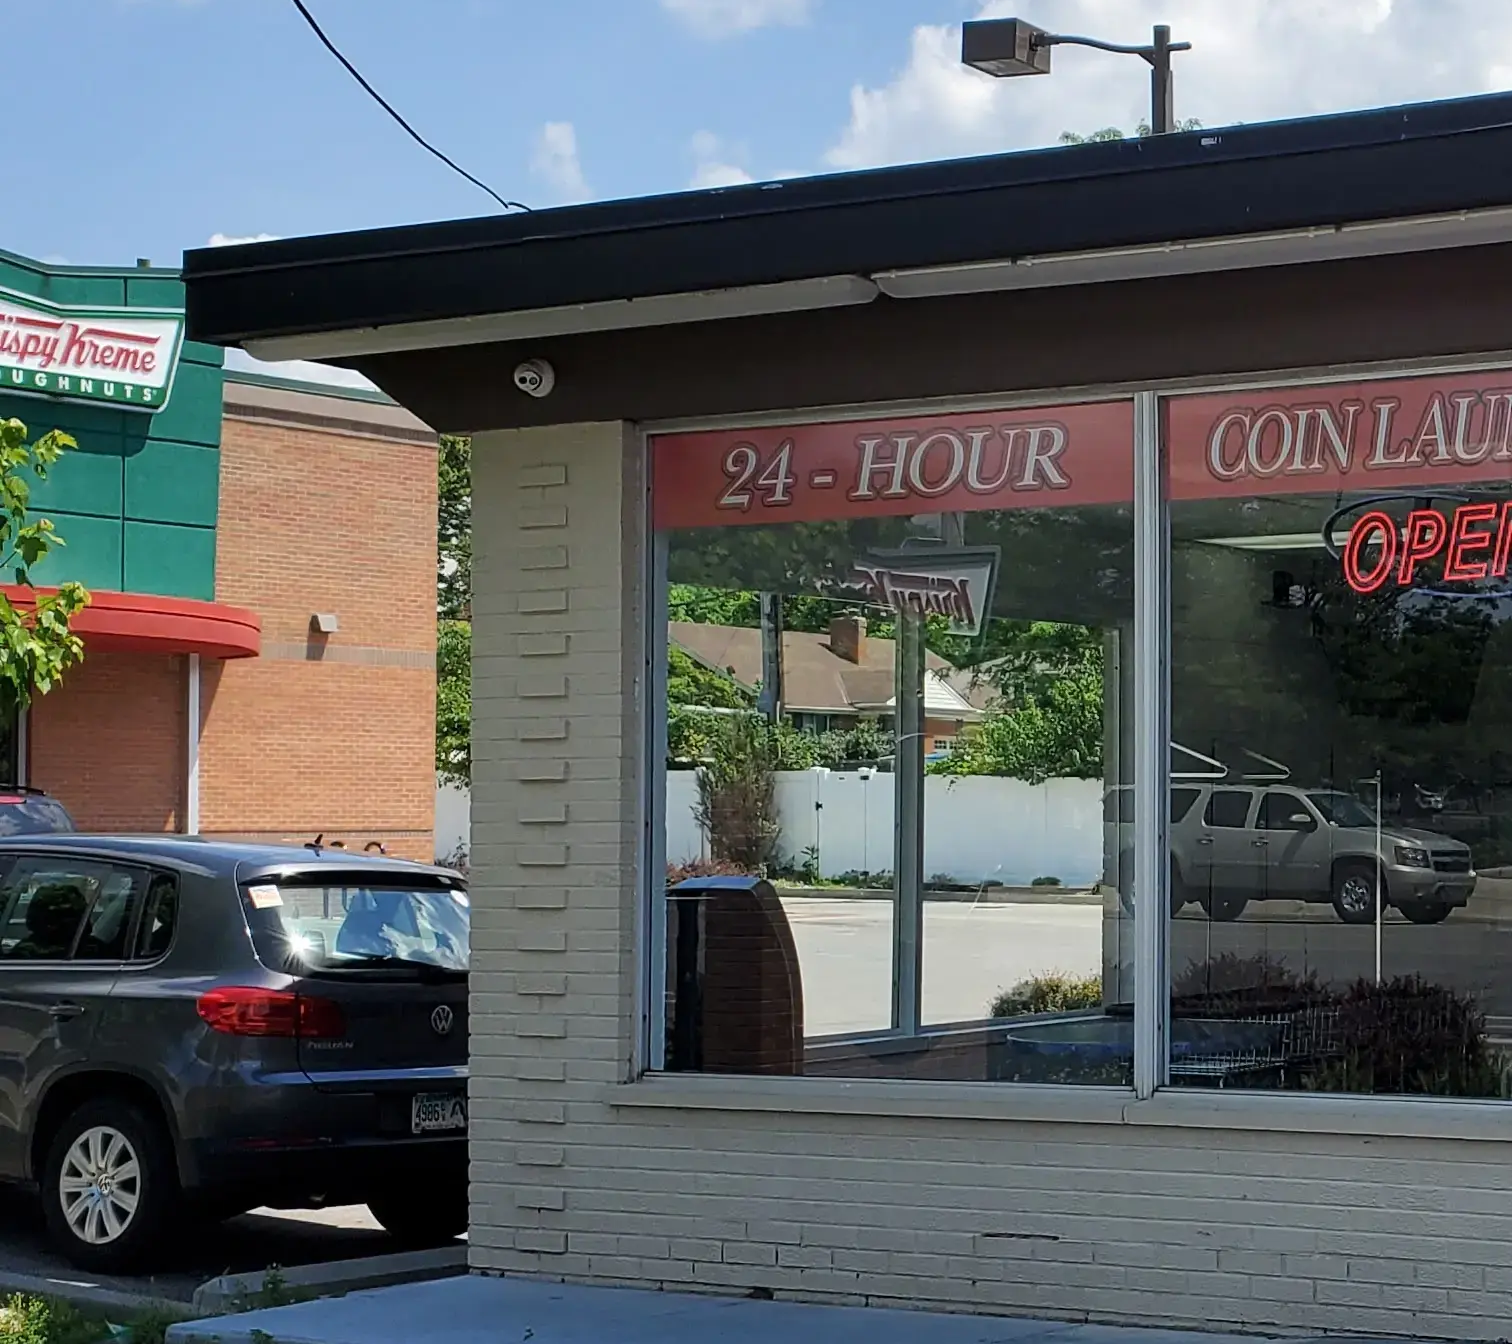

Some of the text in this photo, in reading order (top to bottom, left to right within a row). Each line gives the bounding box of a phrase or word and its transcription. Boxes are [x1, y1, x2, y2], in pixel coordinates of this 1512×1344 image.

[0, 314, 161, 374] ispy Kreme
[0, 369, 153, 402] UGHNUTS
[717, 440, 795, 507] 24
[850, 424, 1068, 498] HOUR
[1208, 402, 1361, 478] COIN
